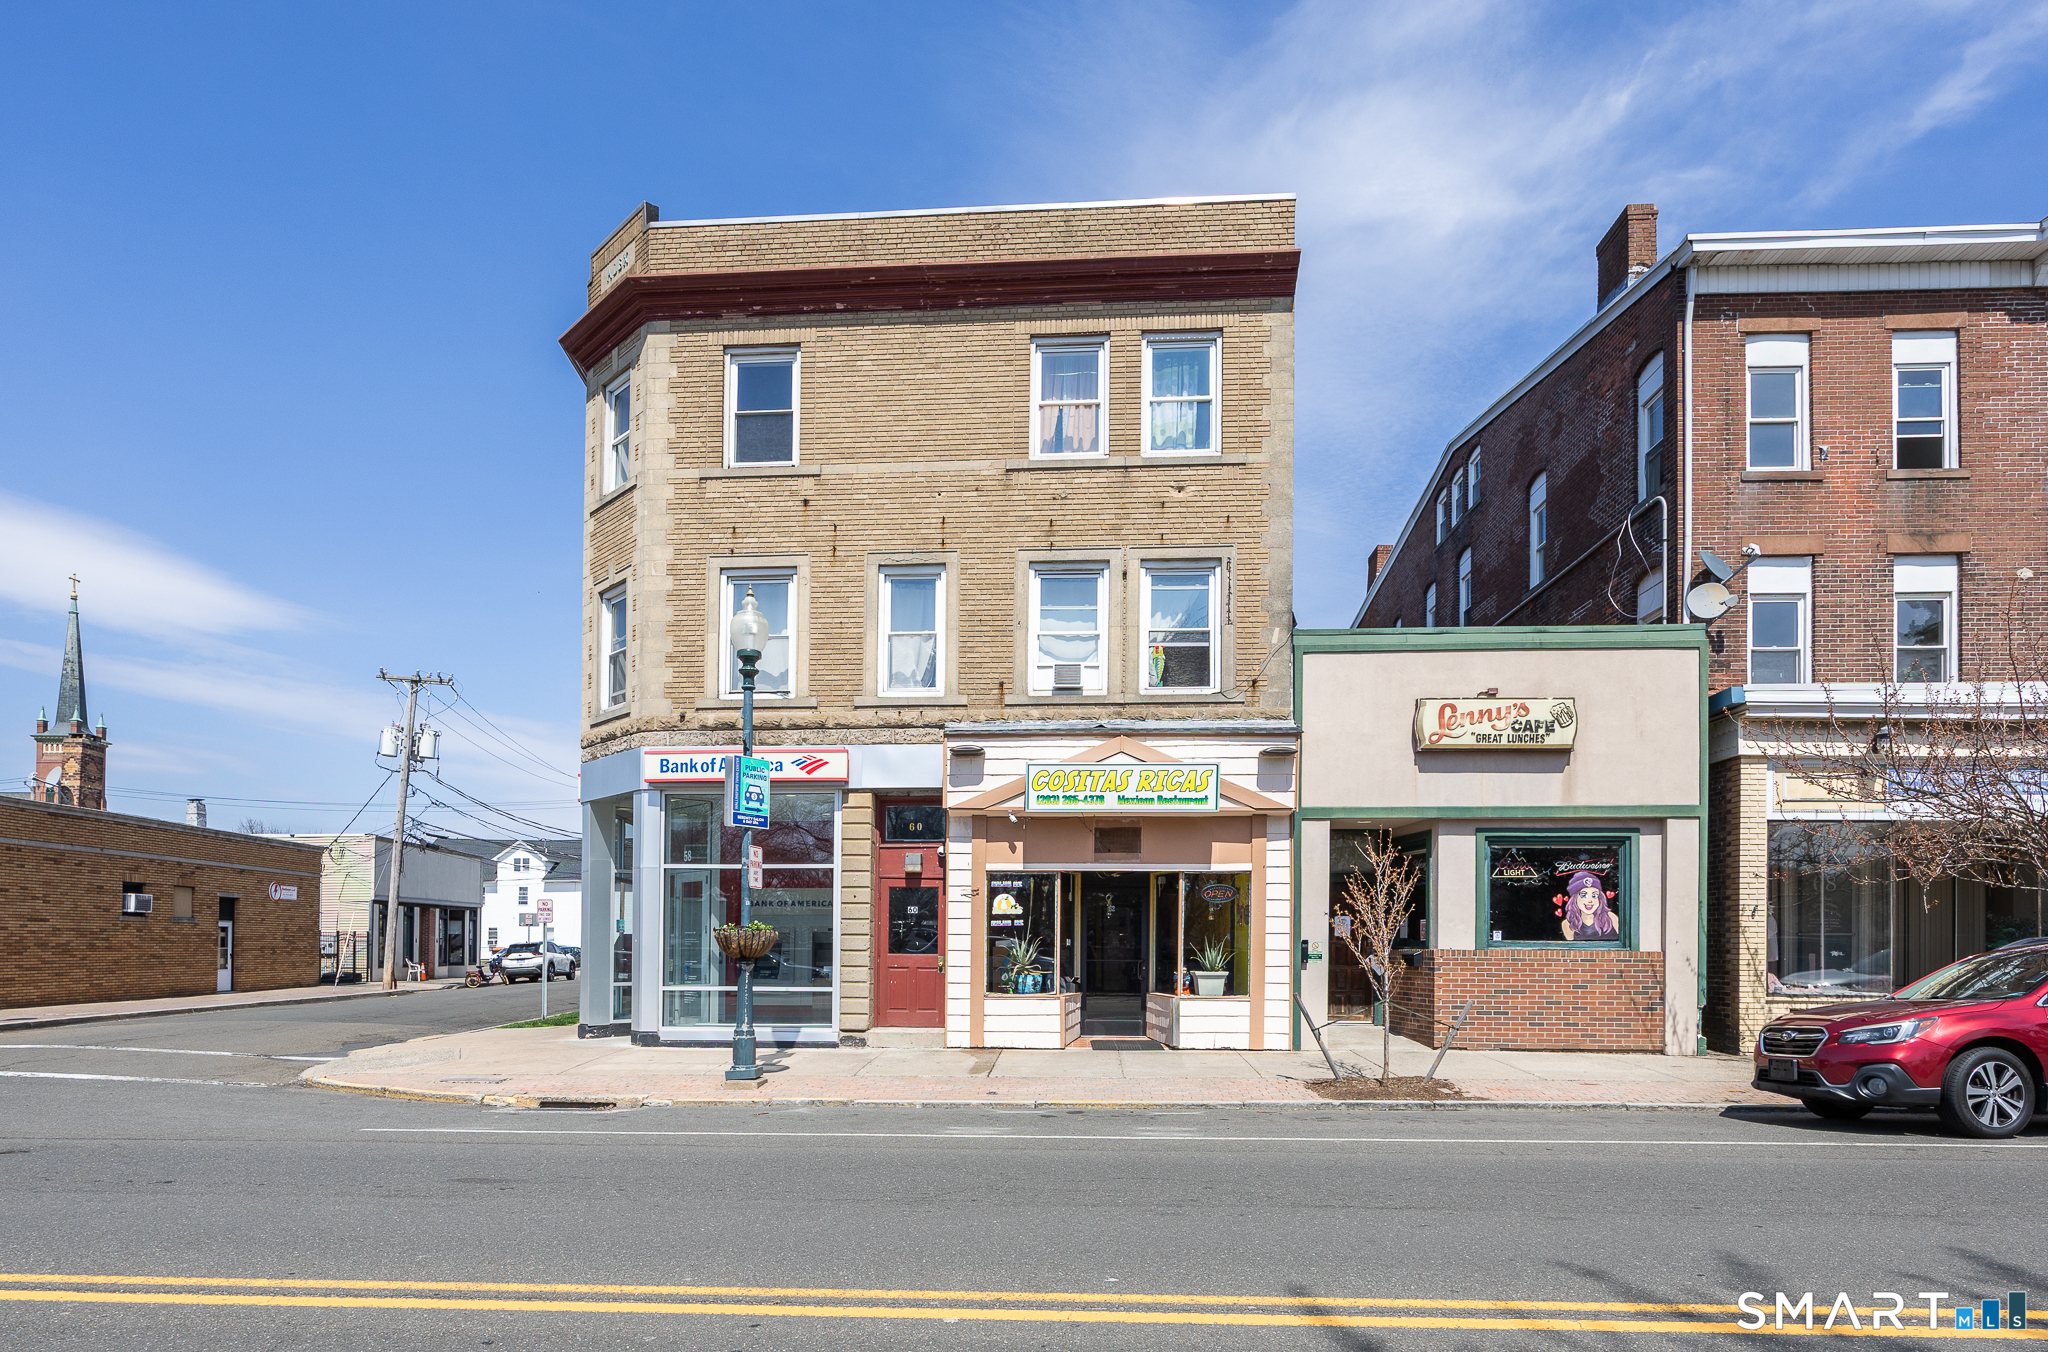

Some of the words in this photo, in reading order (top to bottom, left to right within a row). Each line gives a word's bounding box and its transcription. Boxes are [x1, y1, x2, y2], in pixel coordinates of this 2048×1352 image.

[1428, 702, 1530, 744] Lenny's
[1511, 719, 1555, 733] CAFE
[1471, 732, 1503, 744] "GREAT
[1507, 732, 1550, 744] LUNCHES"
[660, 758, 698, 773] Bank
[700, 757, 716, 773] of
[745, 765, 765, 774] PUBLIC
[743, 772, 767, 782] PARKING
[1032, 770, 1133, 792] COSITAS
[1136, 770, 1213, 792] RICAS
[1036, 795, 1060, 805] (203)
[1117, 795, 1155, 805] Mexican
[1157, 795, 1208, 805] Restaurant
[909, 822, 923, 831] 60
[683, 850, 692, 862] 58
[753, 850, 759, 858] NO
[1555, 861, 1613, 872] Budweiser
[1204, 890, 1233, 898] OPEN
